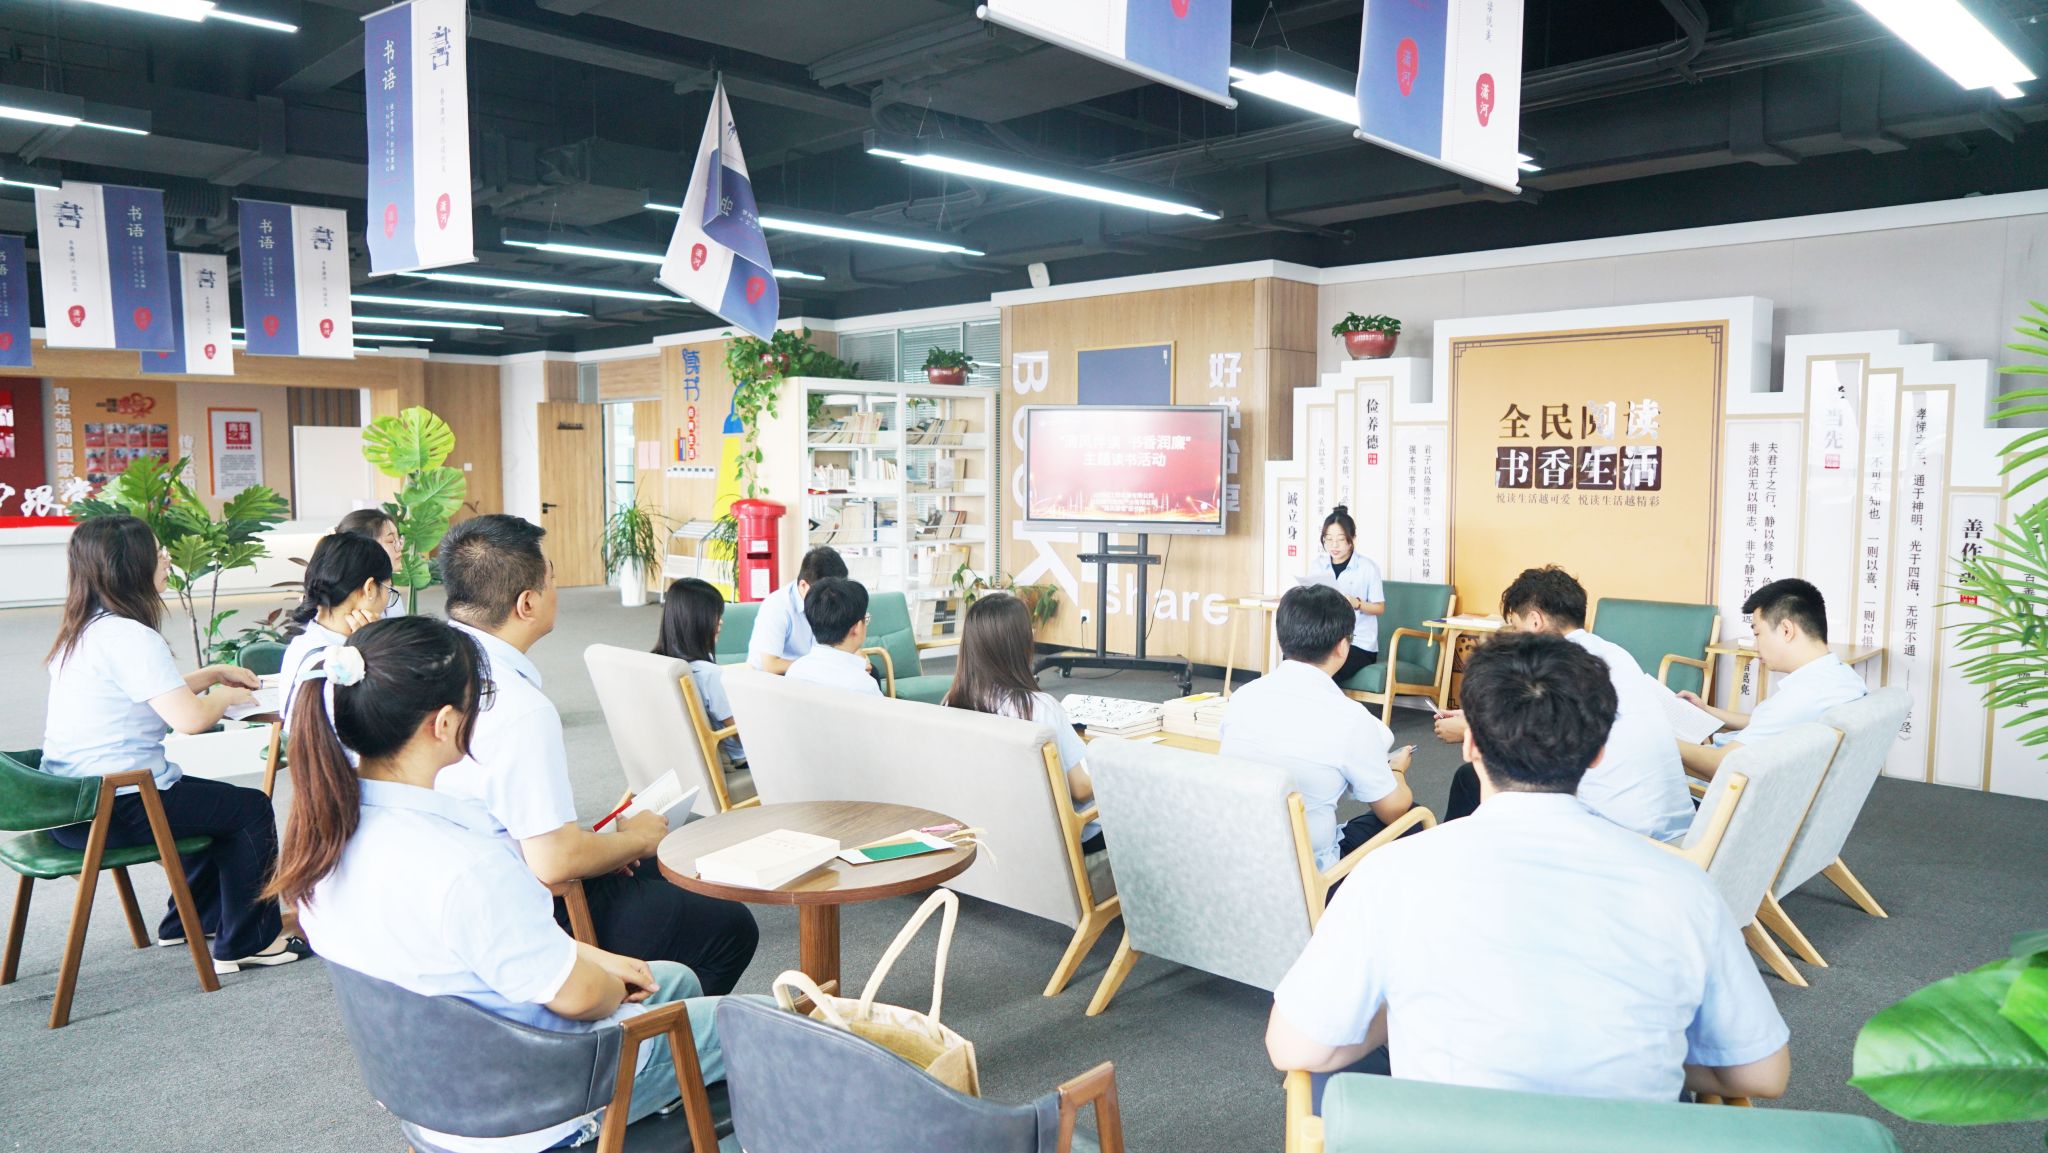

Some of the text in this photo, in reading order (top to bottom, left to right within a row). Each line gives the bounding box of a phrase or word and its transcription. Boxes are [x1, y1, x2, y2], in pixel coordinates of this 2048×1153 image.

[382, 39, 397, 91] 书语
[126, 205, 145, 238] 书语
[259, 218, 275, 250] 书语
[1366, 398, 1379, 450] 俭养德
[1498, 398, 1661, 440] 全民阅读
[1495, 446, 1661, 490] 书香生活
[1496, 492, 1661, 508] 悦读生活越可爱 悦读生活越精彩
[1106, 572, 1230, 626] share
